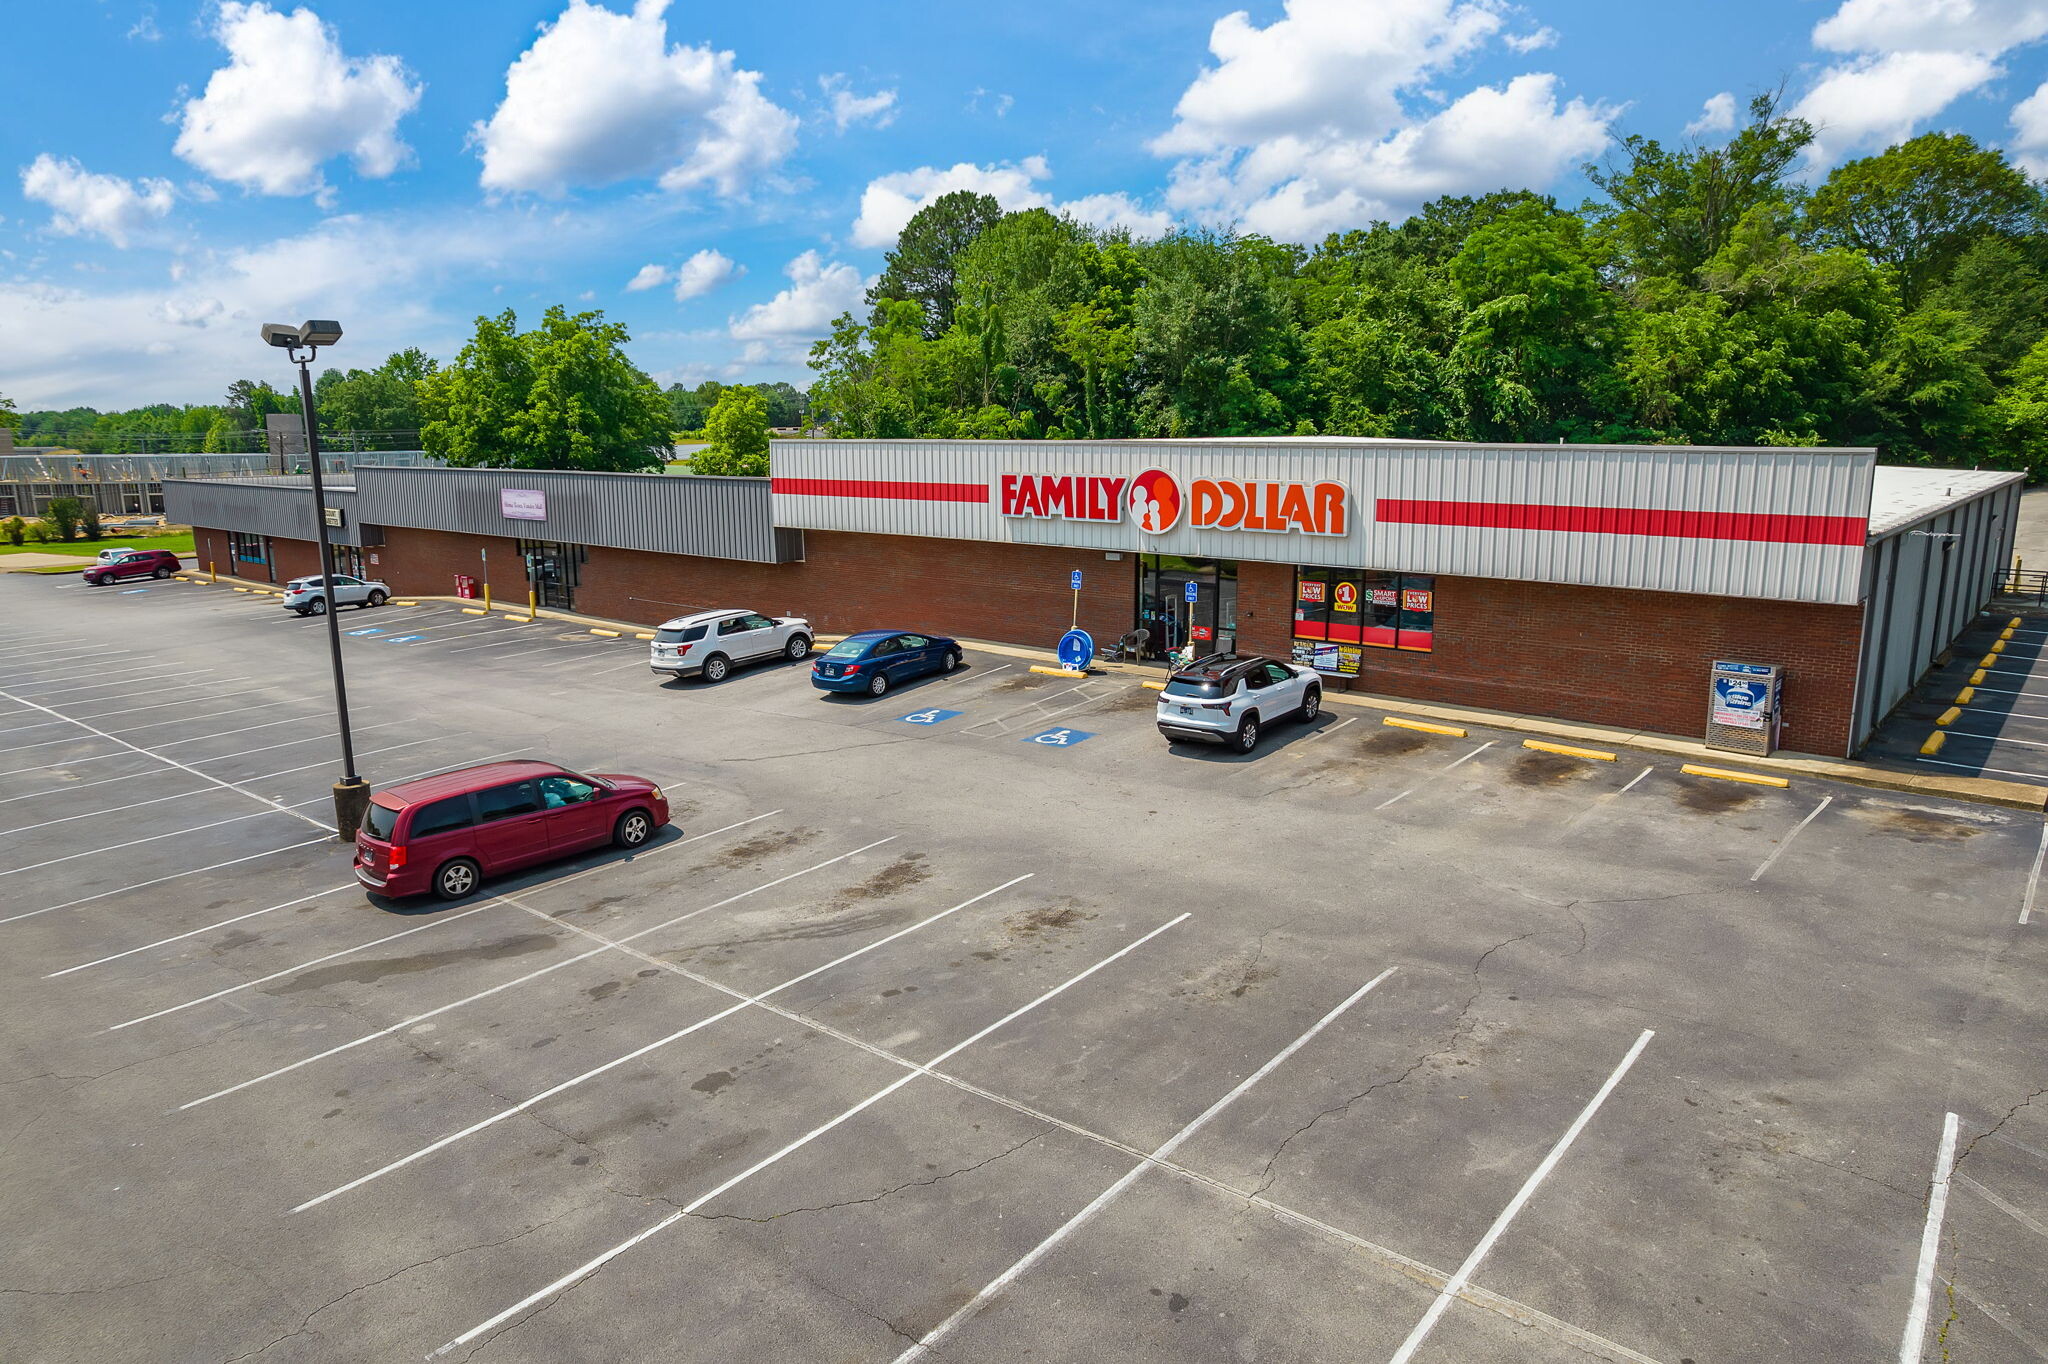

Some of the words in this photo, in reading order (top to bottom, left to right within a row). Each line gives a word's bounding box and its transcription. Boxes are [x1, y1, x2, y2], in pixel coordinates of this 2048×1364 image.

[1001, 474, 1126, 521] FAMILY
[1191, 478, 1345, 534] DOLLAR
[1302, 586, 1320, 594] LOW
[1338, 586, 1350, 601] $1
[1407, 595, 1428, 603] LOW
